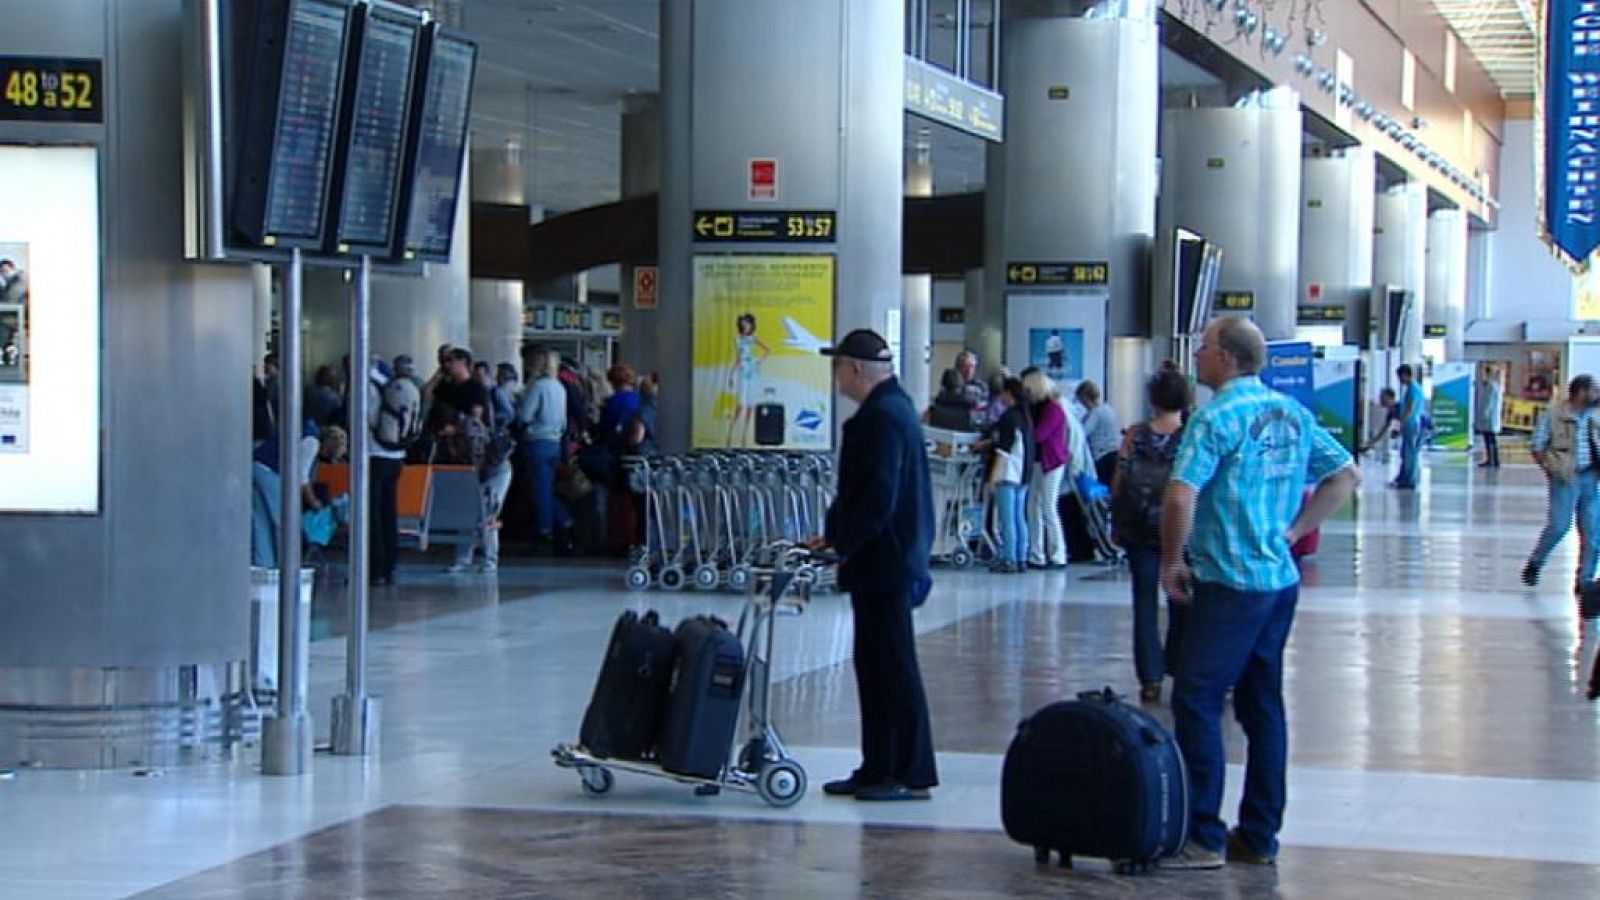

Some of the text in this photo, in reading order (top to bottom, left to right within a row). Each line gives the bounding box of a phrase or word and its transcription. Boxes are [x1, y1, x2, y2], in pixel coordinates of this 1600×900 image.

[5, 70, 93, 108] 48 to a 52
[1566, 72, 1600, 225] WEIHNACHTEN
[787, 216, 804, 237] 53
[814, 217, 832, 237] 57
